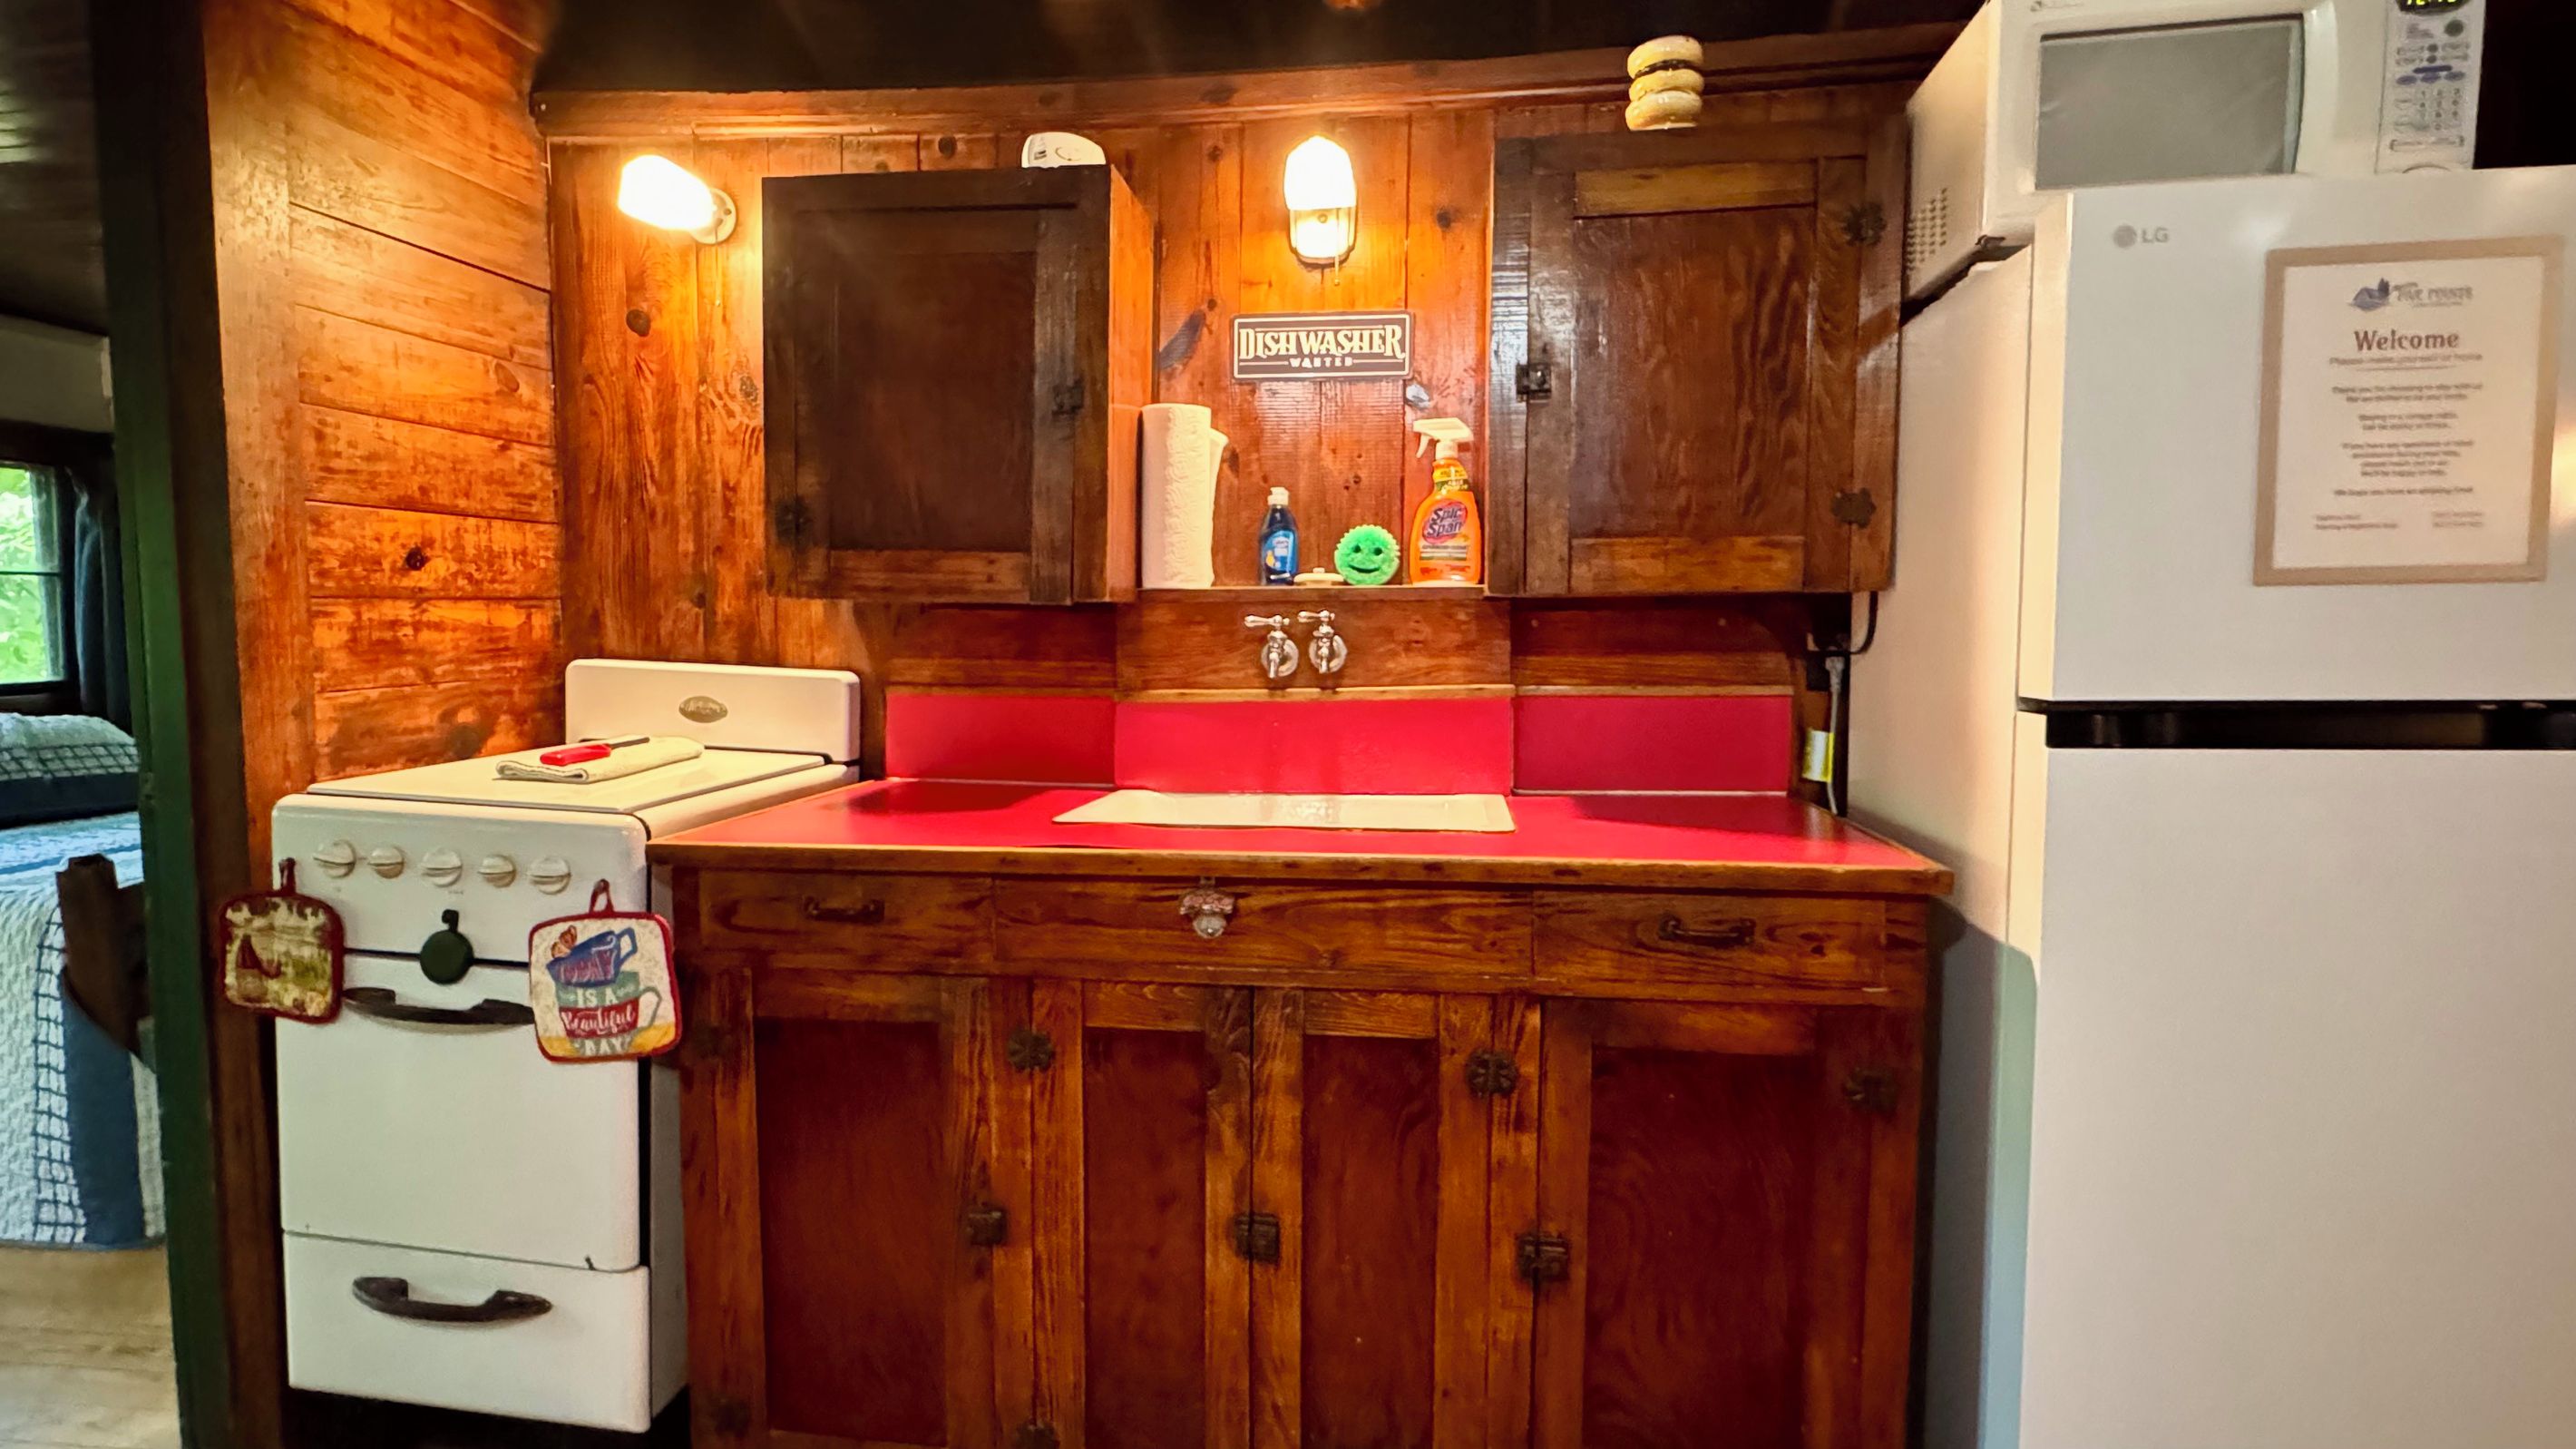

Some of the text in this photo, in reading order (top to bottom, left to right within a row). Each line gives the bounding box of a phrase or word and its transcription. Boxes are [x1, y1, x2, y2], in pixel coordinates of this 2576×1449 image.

[2142, 226, 2170, 243] LG
[1239, 325, 1406, 359] DISHWASHER
[2354, 329, 2460, 351] Welcome
[1289, 357, 1353, 368] WANTED
[1431, 507, 1463, 524] Spic
[1427, 522, 1462, 537] Span
[577, 987, 619, 1008] IS A
[561, 1004, 637, 1035] Beautiful
[585, 1037, 624, 1054] DAY
